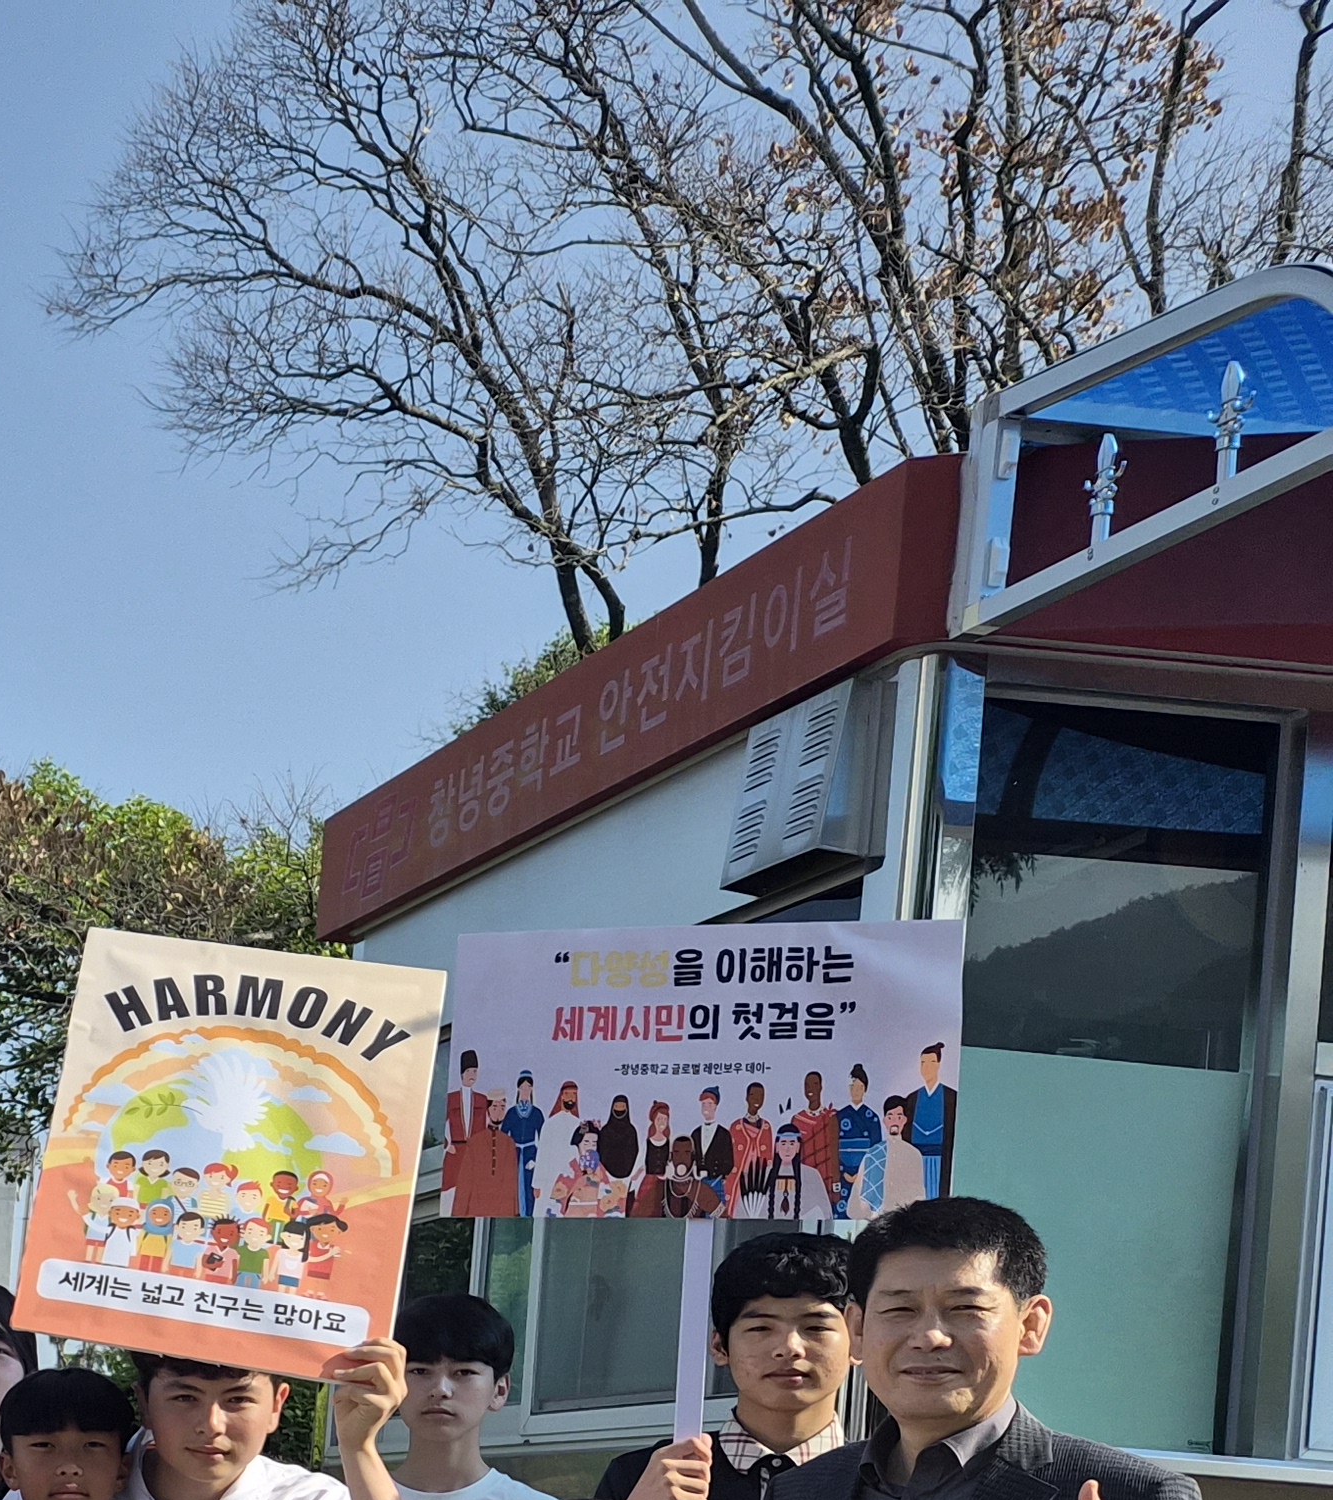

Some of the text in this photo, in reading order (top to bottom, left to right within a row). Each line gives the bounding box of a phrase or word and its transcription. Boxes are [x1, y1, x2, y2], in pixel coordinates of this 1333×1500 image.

[428, 535, 853, 848] 창녕중학교 안전지킴이실
[554, 945, 855, 988] “다양성을 이해하는
[104, 973, 411, 1062] HARMONY
[551, 1001, 857, 1042] 세계시민의 첫걸음”
[671, 1063, 701, 1076] 글로벌
[703, 1062, 743, 1075] 레인보우
[58, 1270, 347, 1333] 세계는 넓고 친구는 많아요
